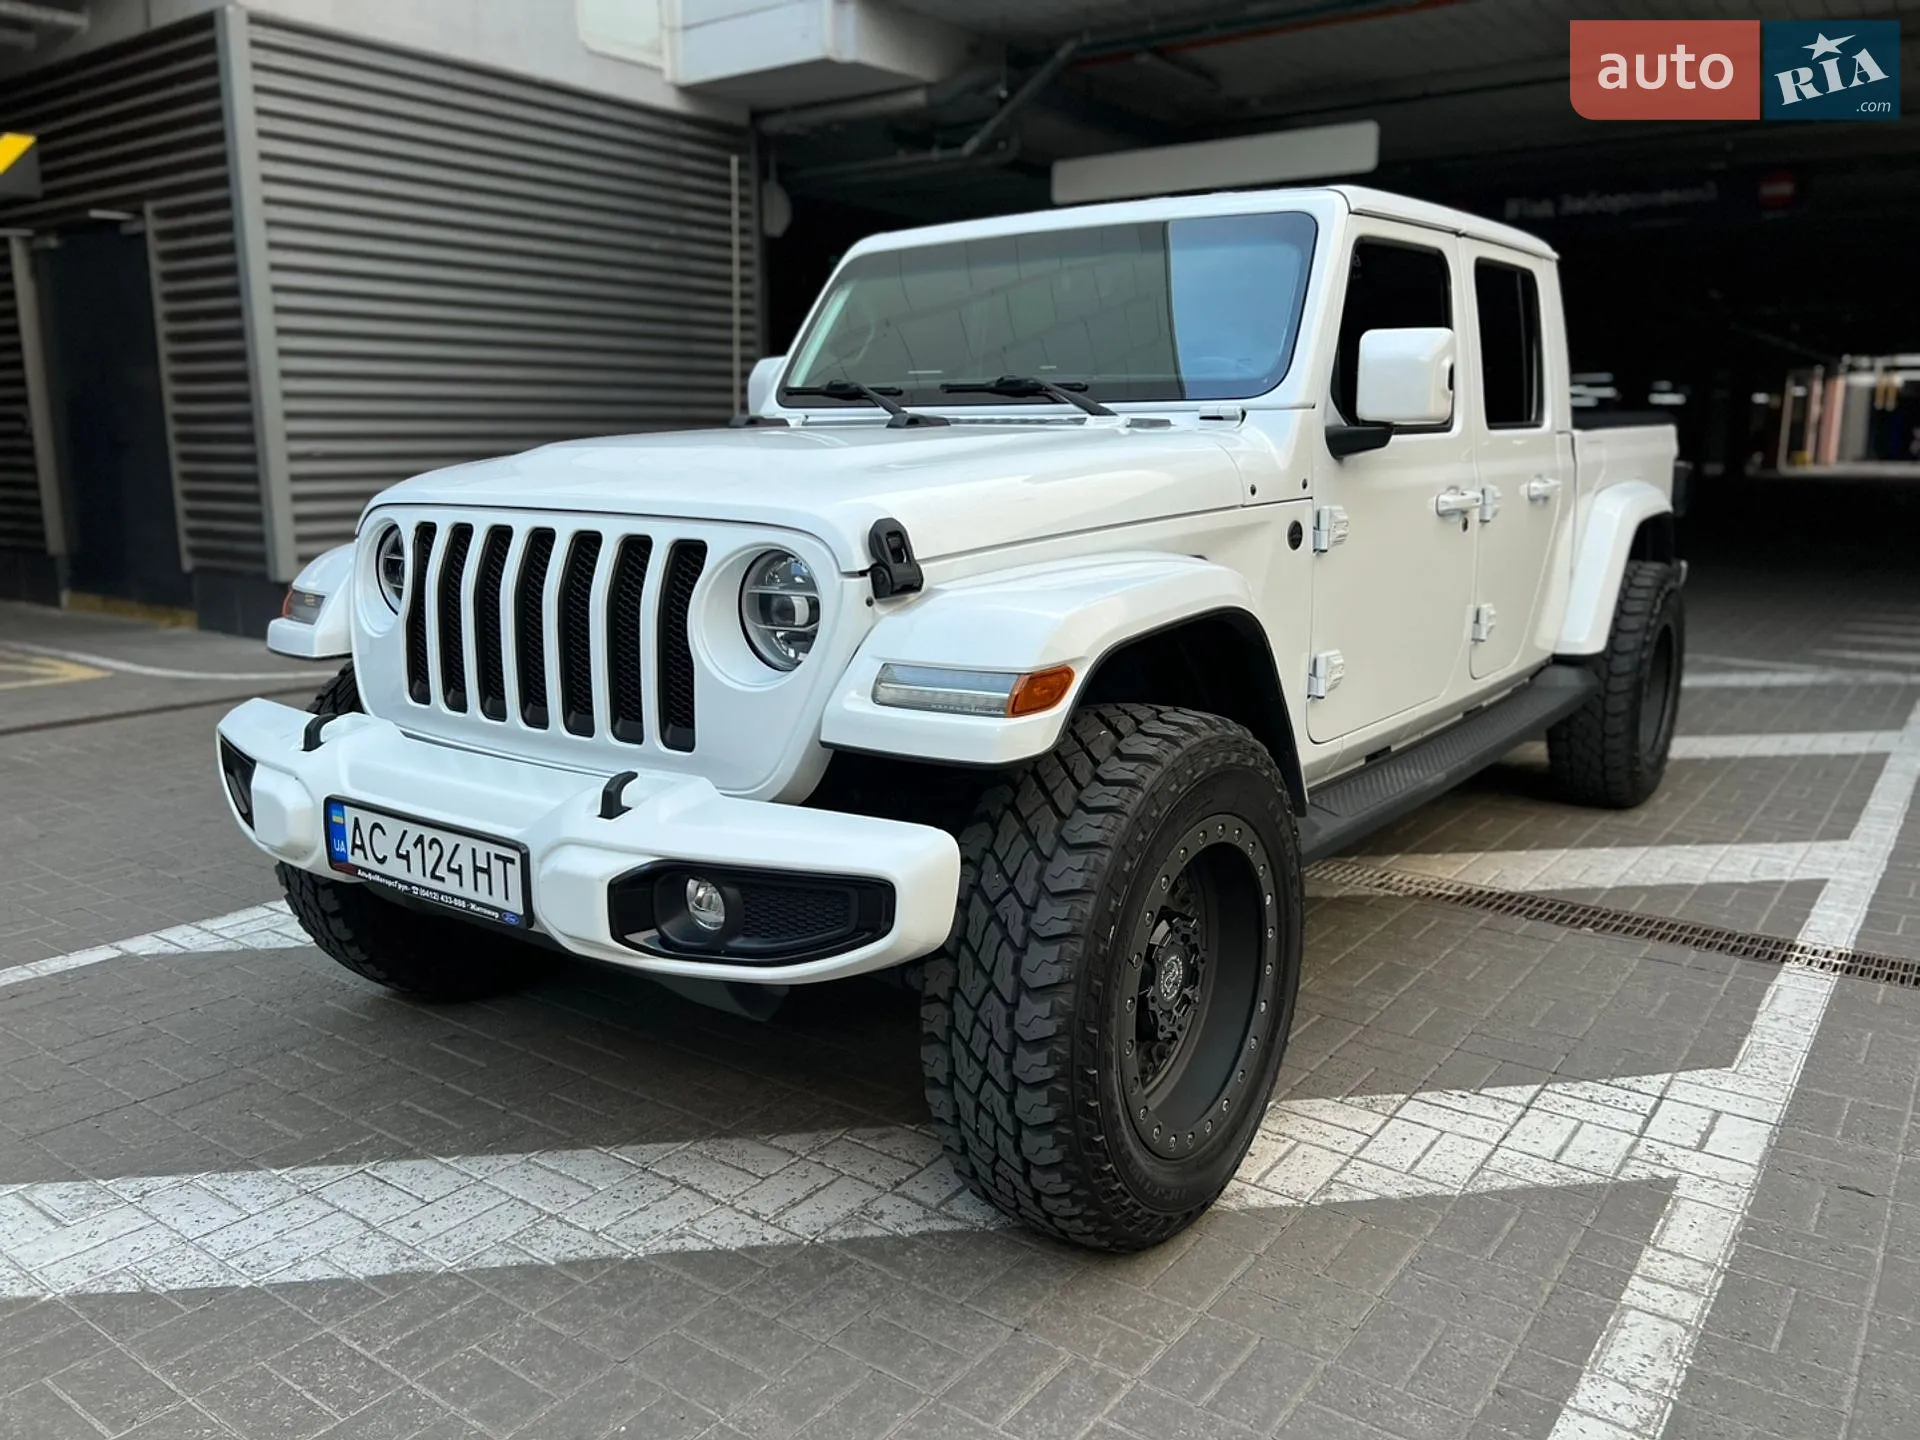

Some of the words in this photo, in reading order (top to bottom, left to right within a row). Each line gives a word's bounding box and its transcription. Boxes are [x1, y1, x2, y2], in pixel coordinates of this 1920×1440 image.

[333, 838, 347, 854] UA
[351, 816, 388, 865] AC
[395, 829, 463, 888] 4124
[472, 847, 516, 902] HT
